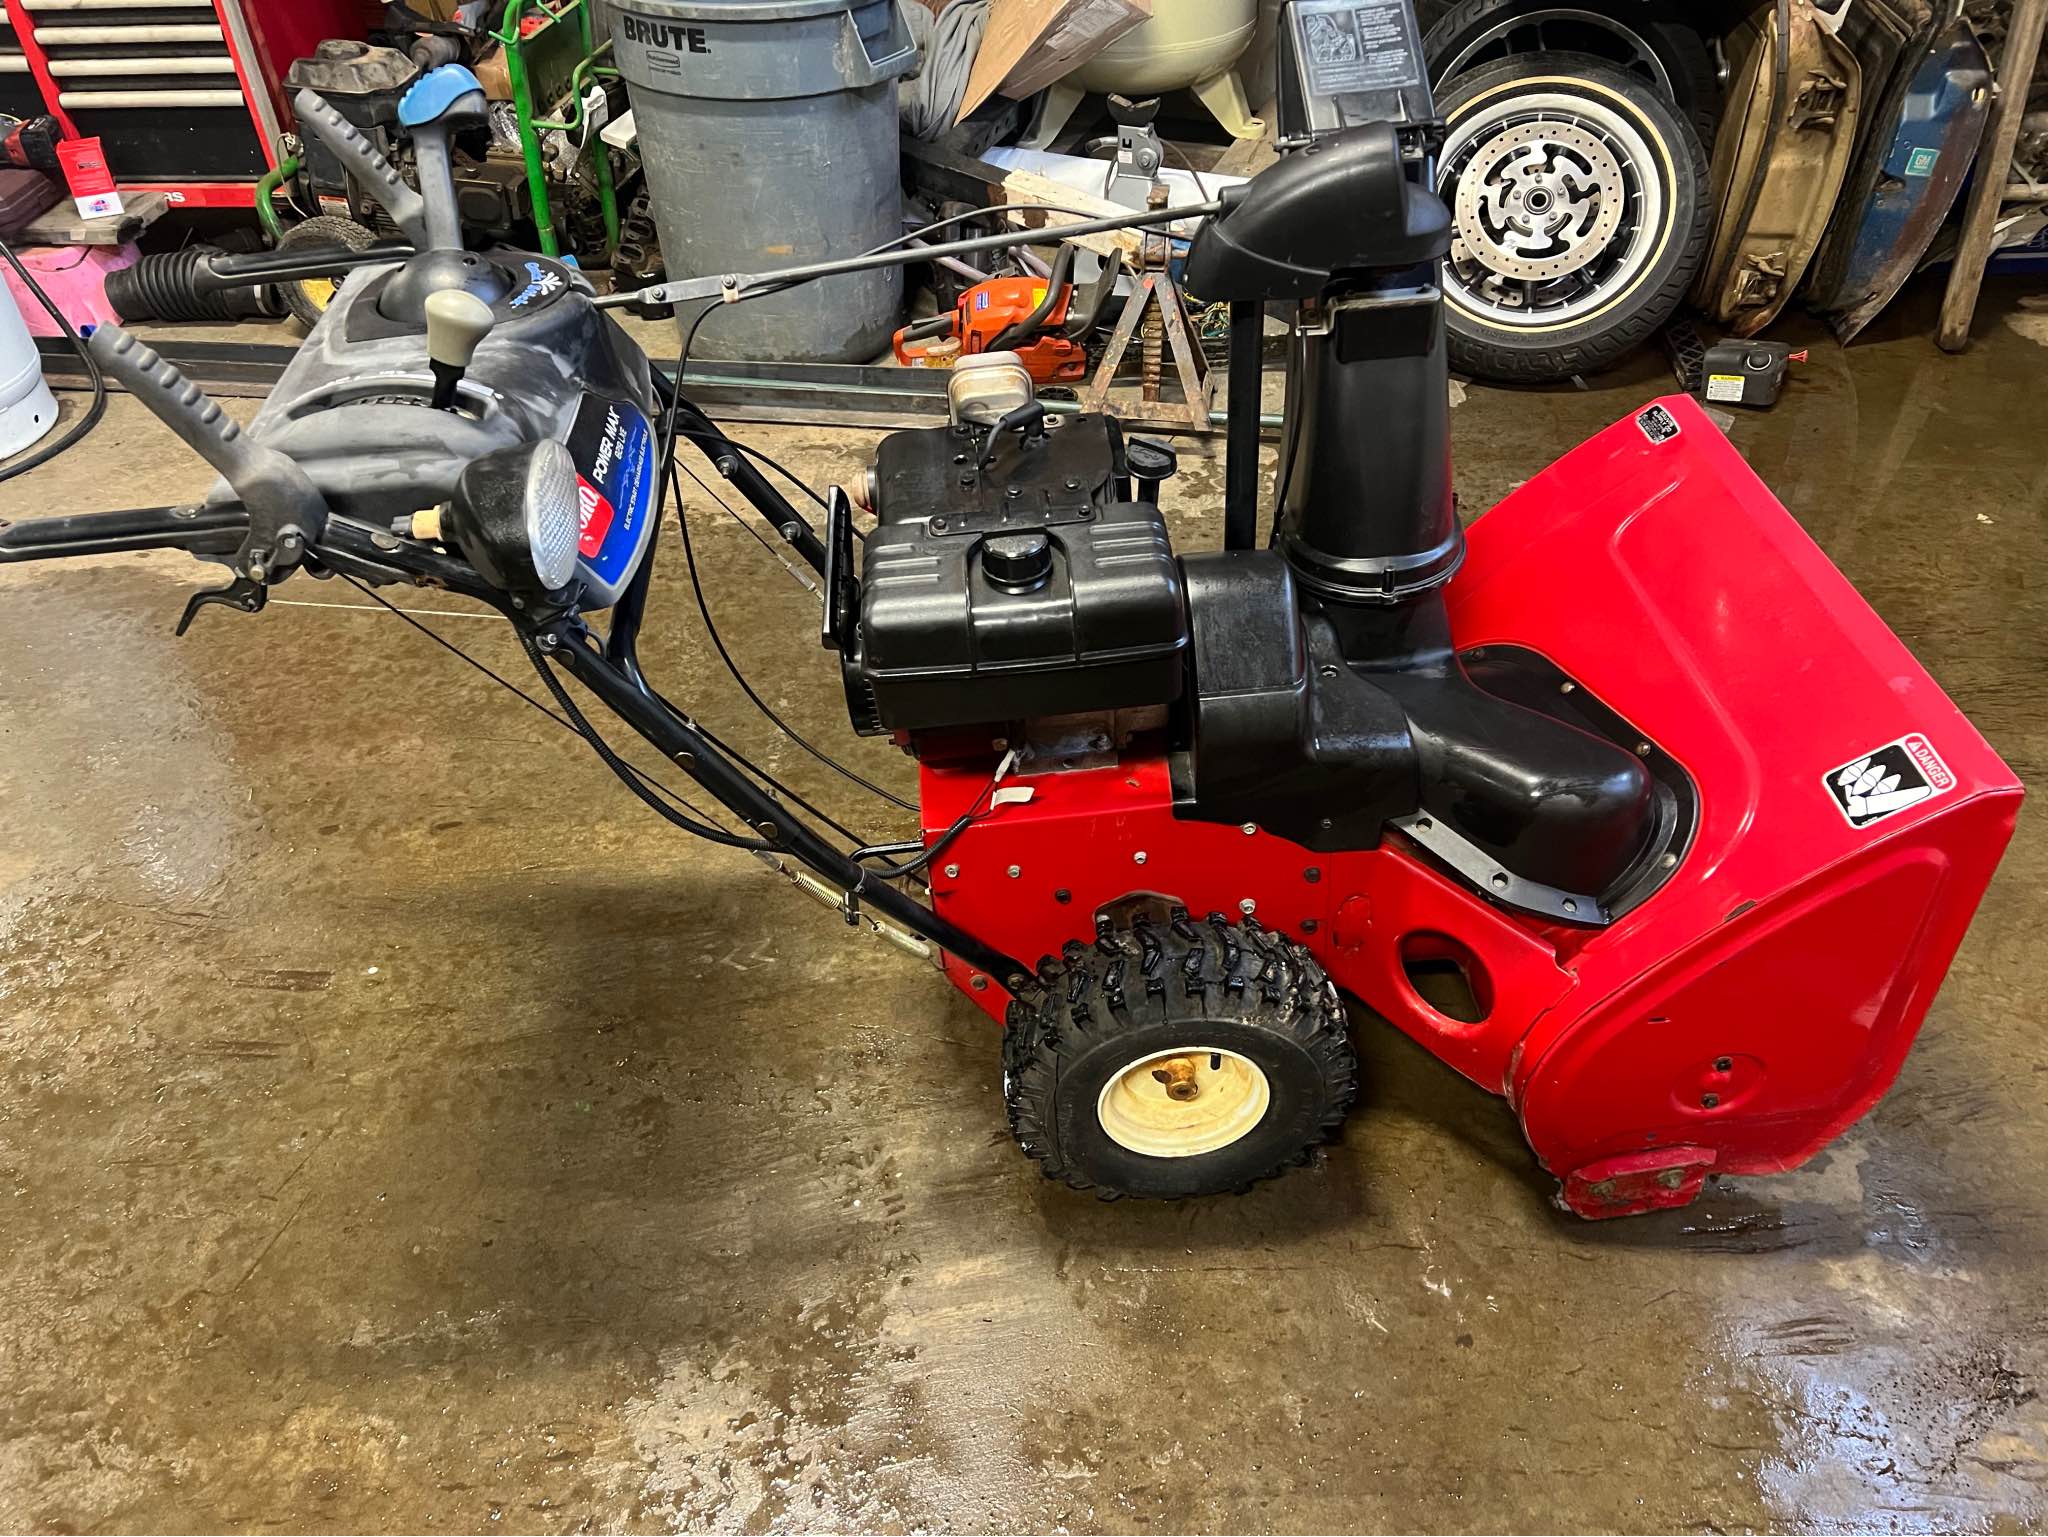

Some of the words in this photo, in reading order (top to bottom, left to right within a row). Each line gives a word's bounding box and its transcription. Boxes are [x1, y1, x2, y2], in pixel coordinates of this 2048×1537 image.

[1915, 154, 1932, 166] GM
[592, 437, 613, 485] POWER
[604, 408, 621, 442] MAX
[628, 486, 638, 507] START
[623, 504, 635, 531] ELECTRIC
[1916, 749, 1949, 787] DANGER
